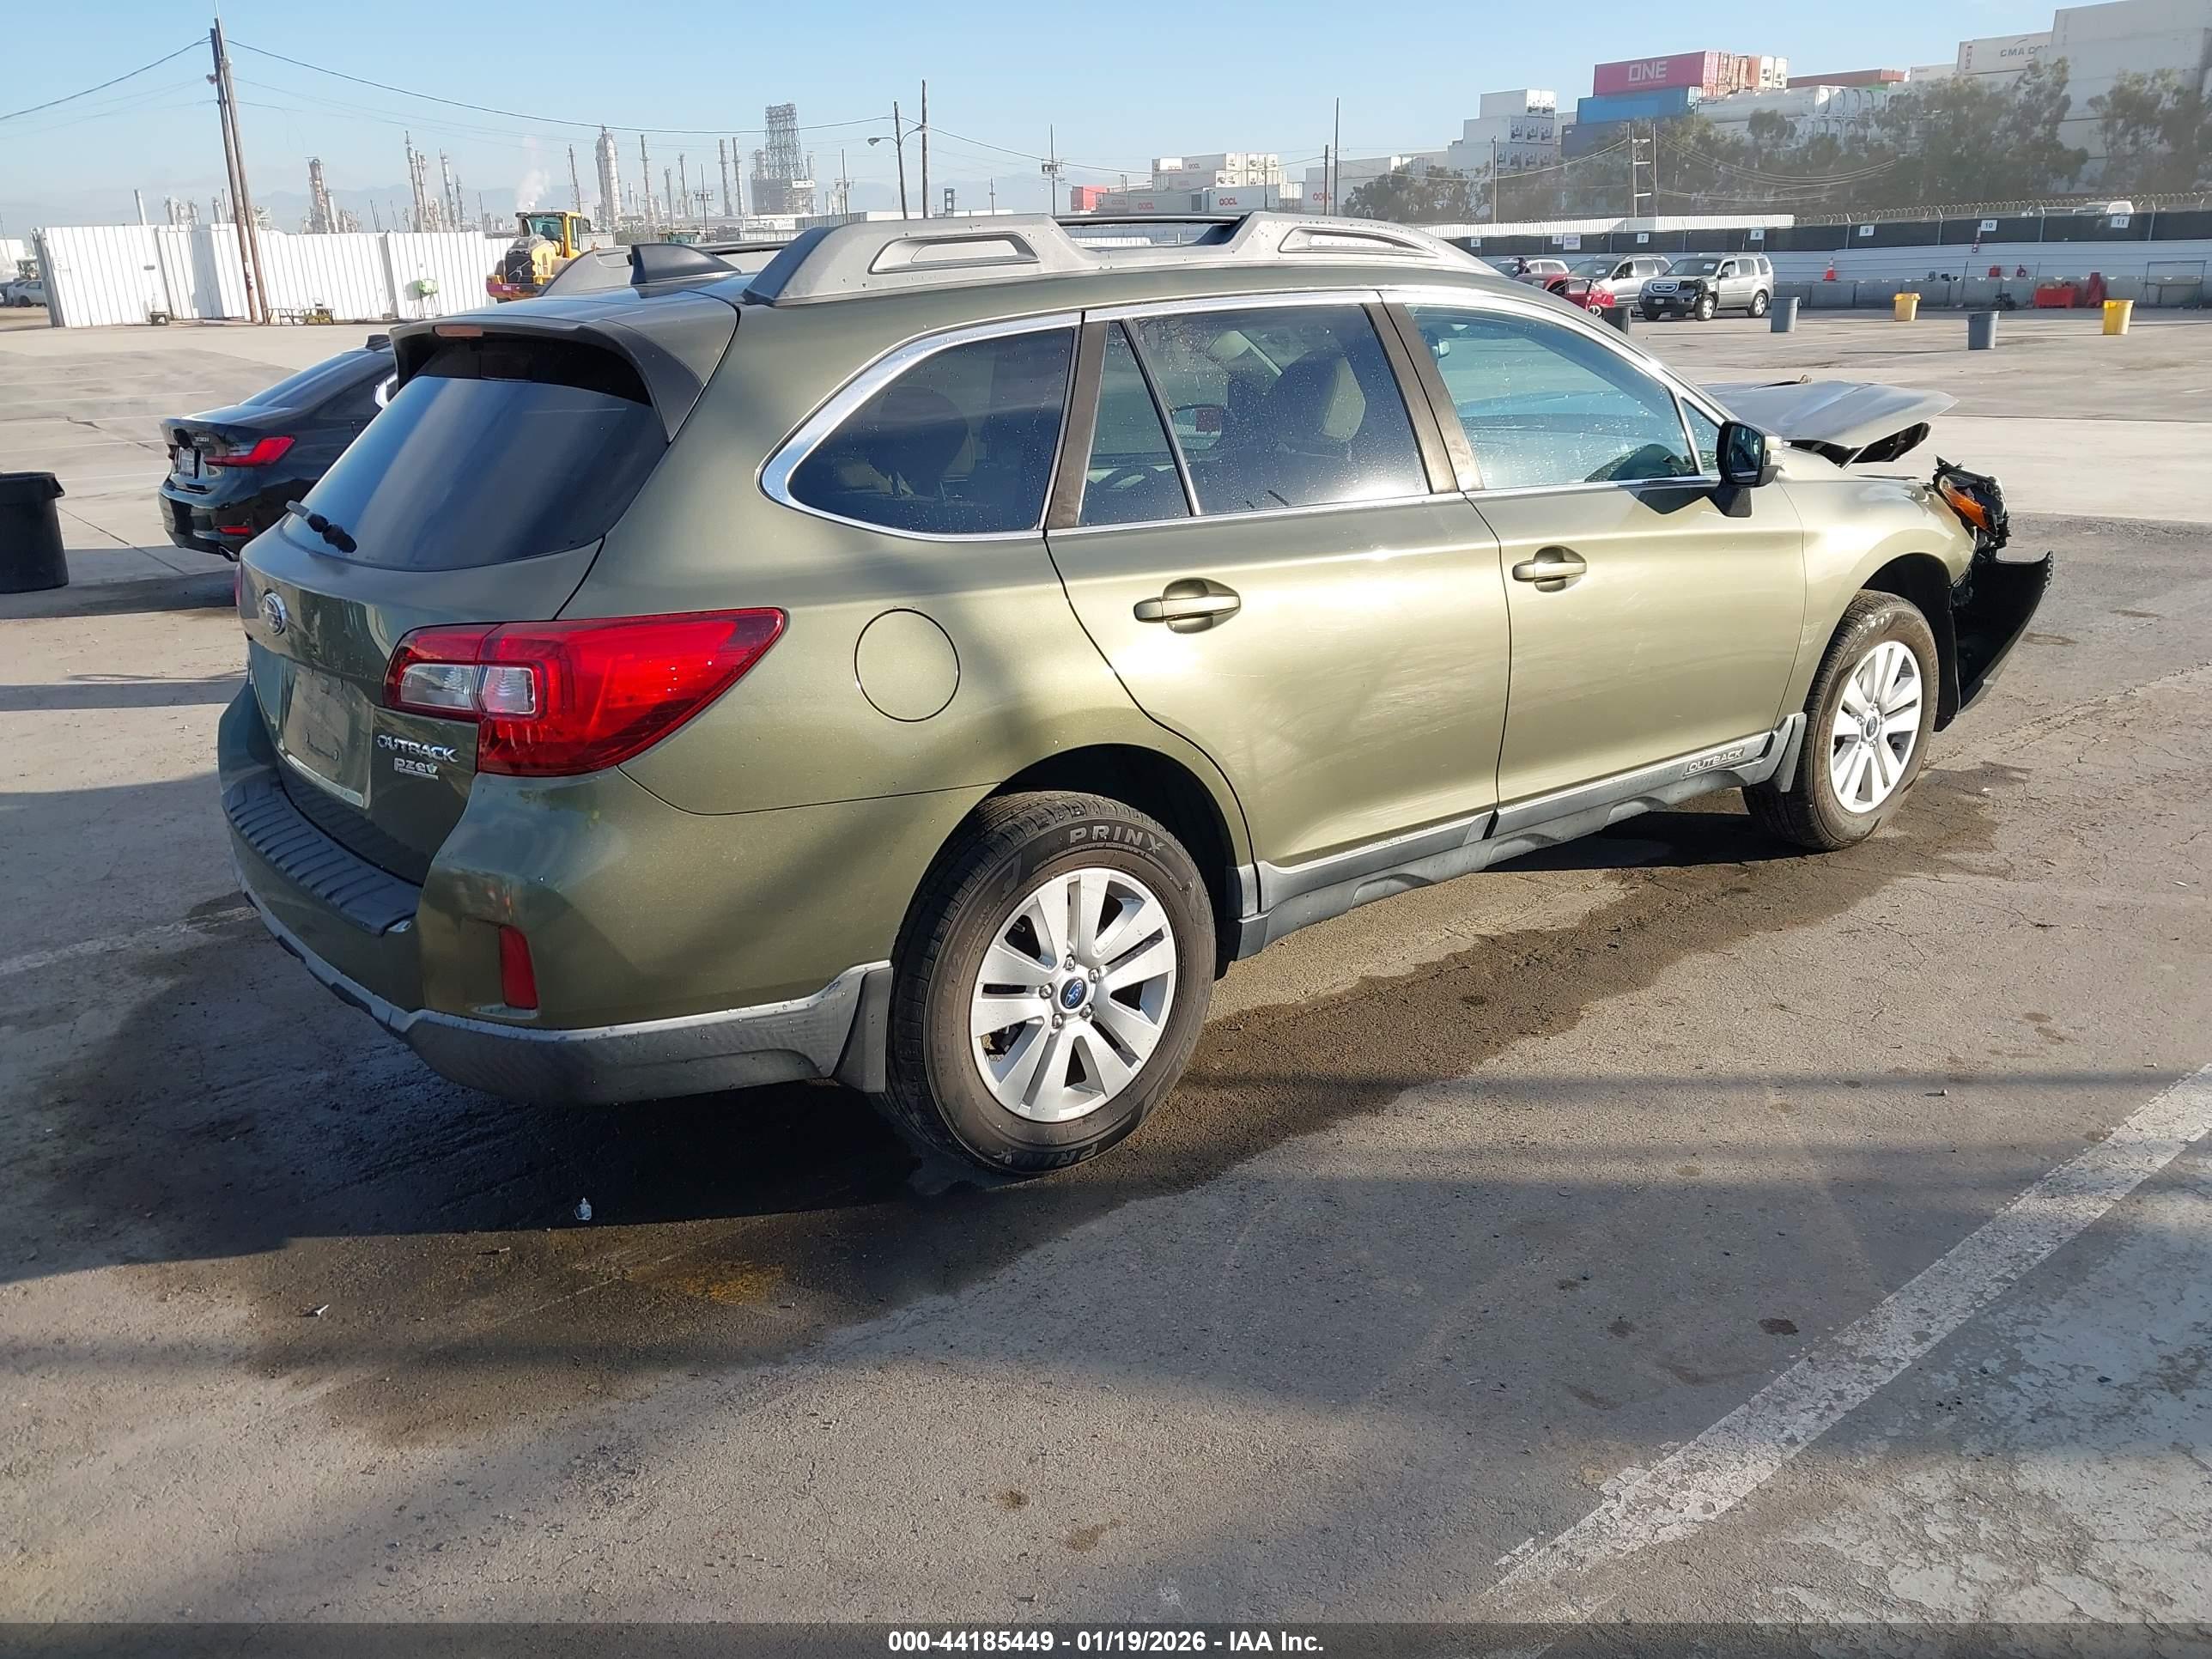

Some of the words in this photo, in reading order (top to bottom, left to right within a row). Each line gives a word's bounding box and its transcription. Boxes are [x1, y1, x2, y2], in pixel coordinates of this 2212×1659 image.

[1999, 47, 2025, 58] CMA
[1628, 61, 1668, 82] ONE
[1218, 198, 1237, 207] OOCL
[377, 734, 459, 763] OUTBACK
[1689, 748, 1743, 771] OUTBACK
[1069, 824, 1165, 854] PRINX
